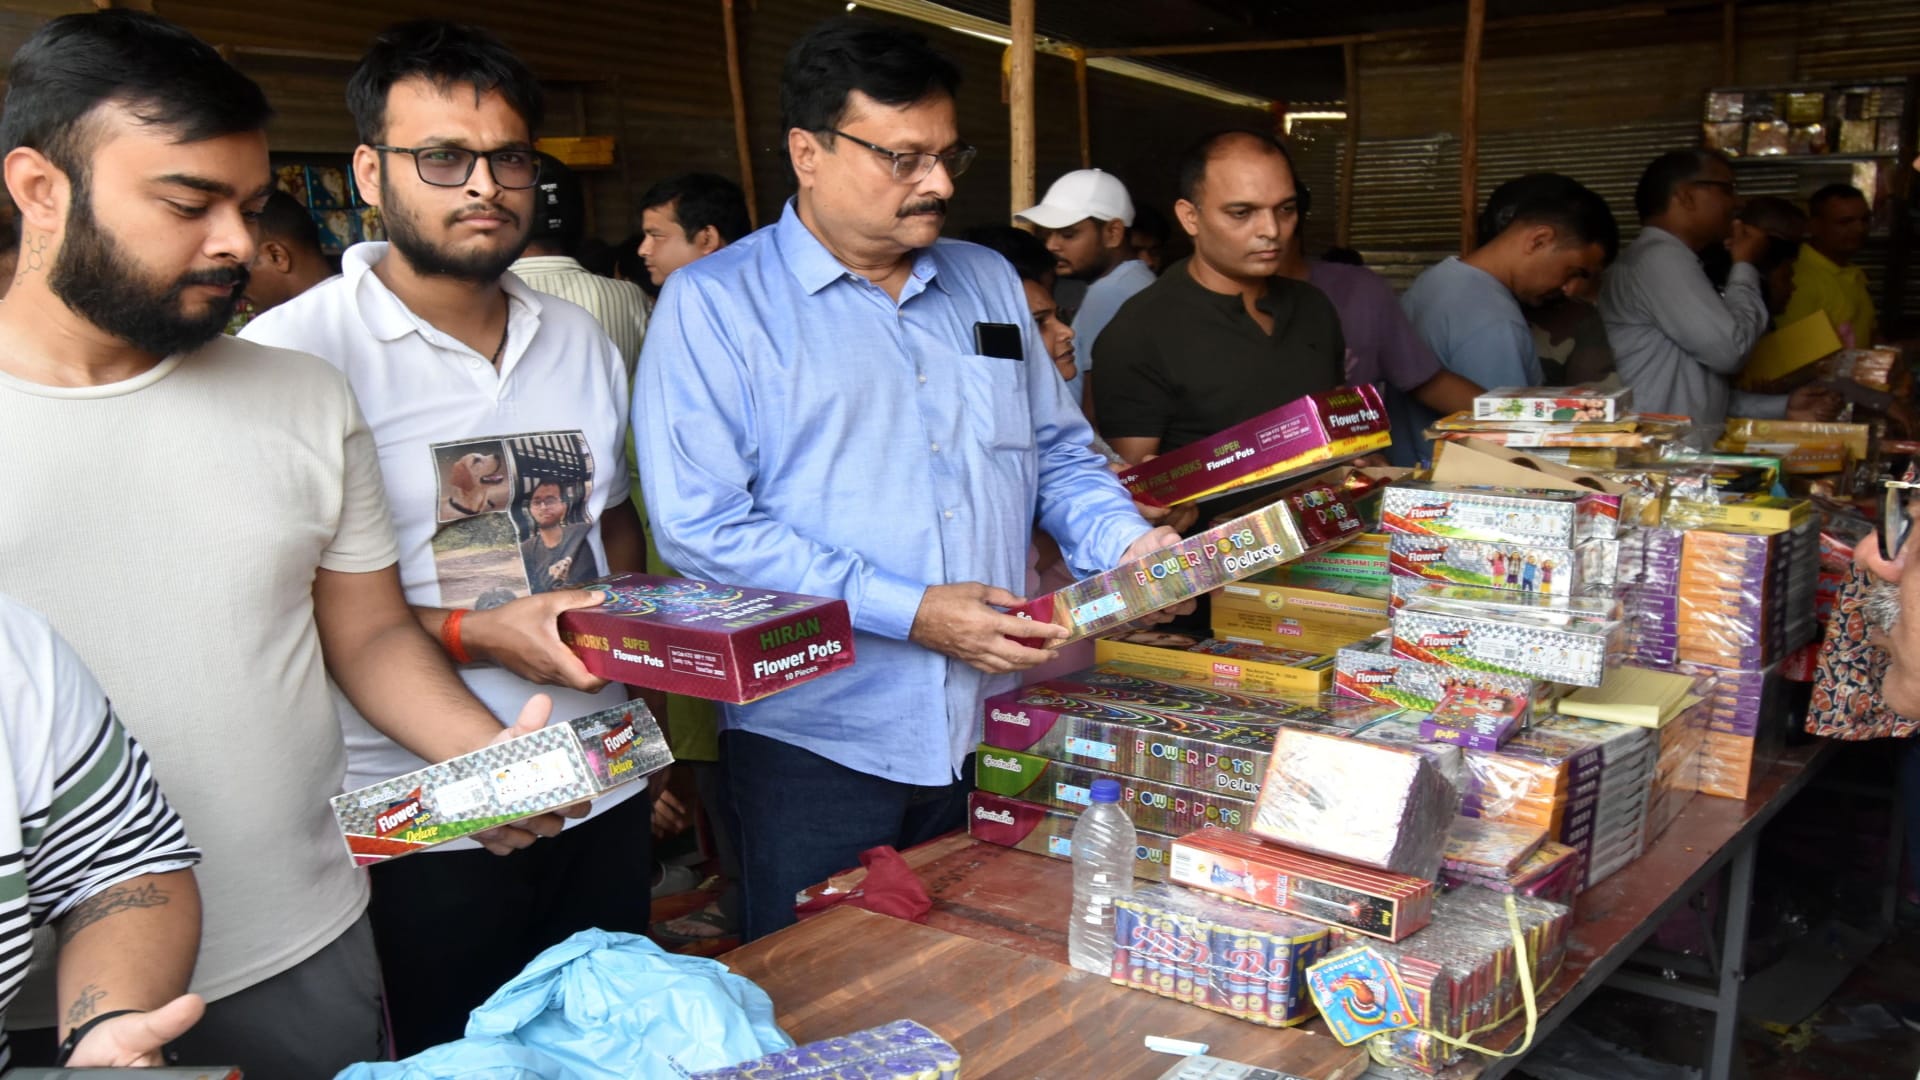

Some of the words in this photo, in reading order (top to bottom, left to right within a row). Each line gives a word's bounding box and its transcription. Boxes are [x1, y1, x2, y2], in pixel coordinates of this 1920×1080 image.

[1328, 412, 1359, 428] Flower
[1360, 409, 1380, 421] Pots
[1213, 440, 1240, 457] SUPER
[1169, 459, 1203, 479] WORKS
[1206, 455, 1235, 471] Flower
[1235, 447, 1255, 460] Pots
[1411, 508, 1446, 518] Flower
[1135, 551, 1201, 586] FLOWER
[1203, 528, 1255, 560] POTS
[1223, 543, 1282, 573] Deluxe
[1408, 552, 1442, 562] Flower
[575, 634, 610, 651] WORKS
[759, 616, 821, 650] HIRAN
[1423, 637, 1463, 647] Flower
[622, 637, 651, 651] SUPER
[613, 648, 643, 664] Flower
[644, 654, 665, 668] Pots
[753, 651, 806, 679] Flower
[807, 639, 842, 661] Pots
[784, 672, 794, 681] 10
[794, 665, 819, 679] Pieces
[1356, 673, 1393, 683] Flower
[604, 725, 635, 753] Flower
[607, 759, 634, 777] Deluxe
[1136, 740, 1199, 765] FLOWER
[1205, 753, 1255, 776] POTS
[1217, 773, 1262, 793] Delux
[1125, 787, 1186, 814] FLOWER
[1193, 802, 1241, 825] POTS
[378, 801, 419, 833] Flower
[406, 826, 439, 844] Deluxe
[1136, 845, 1170, 865] OWE
